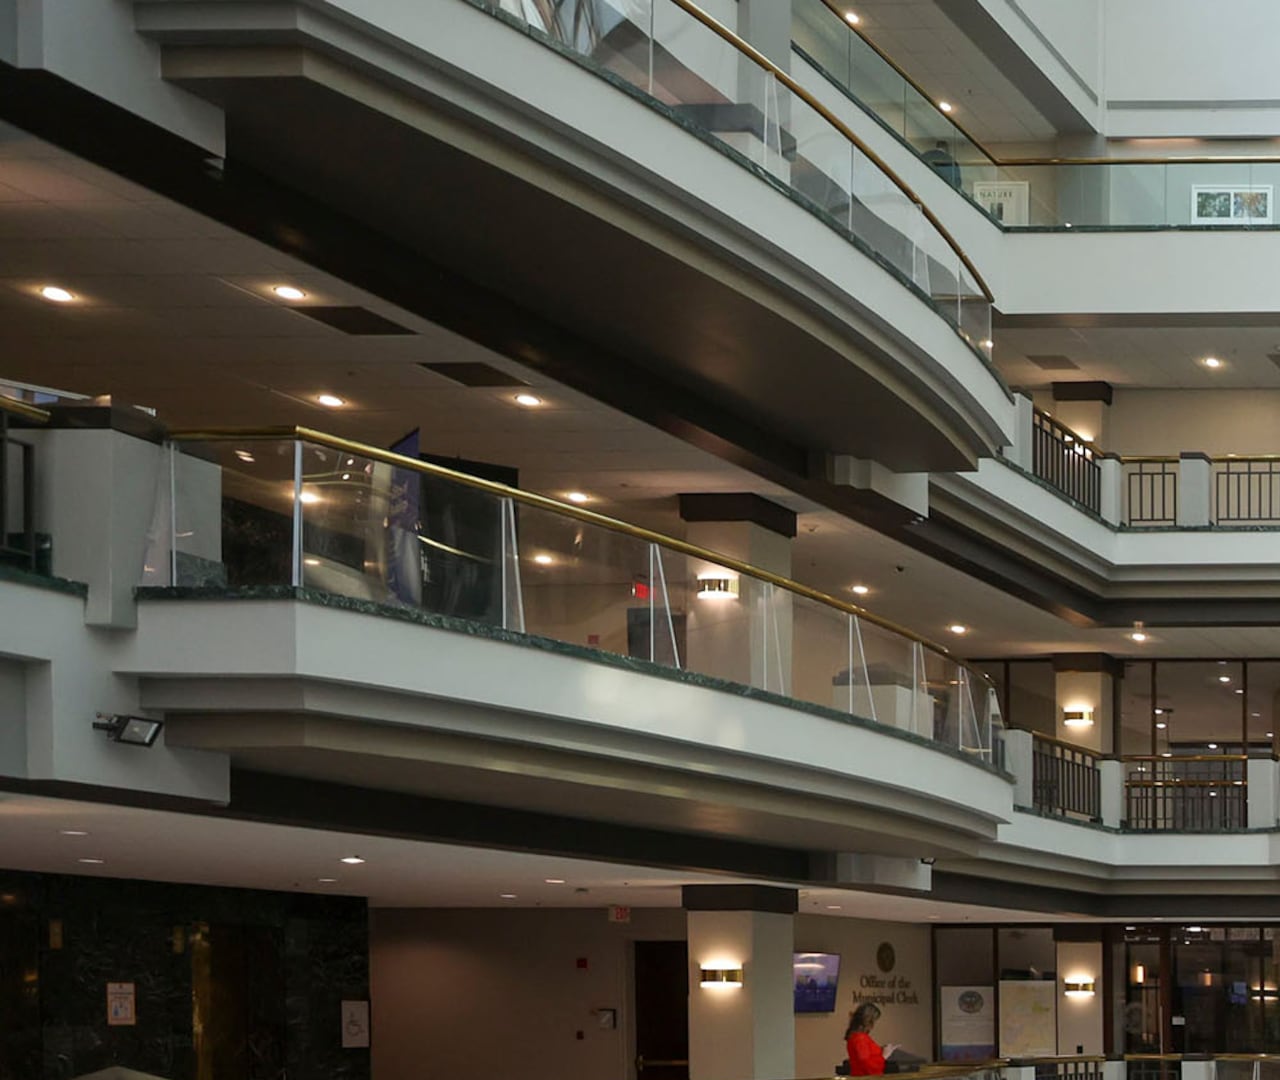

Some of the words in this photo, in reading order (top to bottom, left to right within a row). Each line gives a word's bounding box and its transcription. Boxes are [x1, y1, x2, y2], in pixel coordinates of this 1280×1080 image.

[860, 975, 885, 989] Office
[887, 975, 897, 989] of
[898, 976, 911, 989] the
